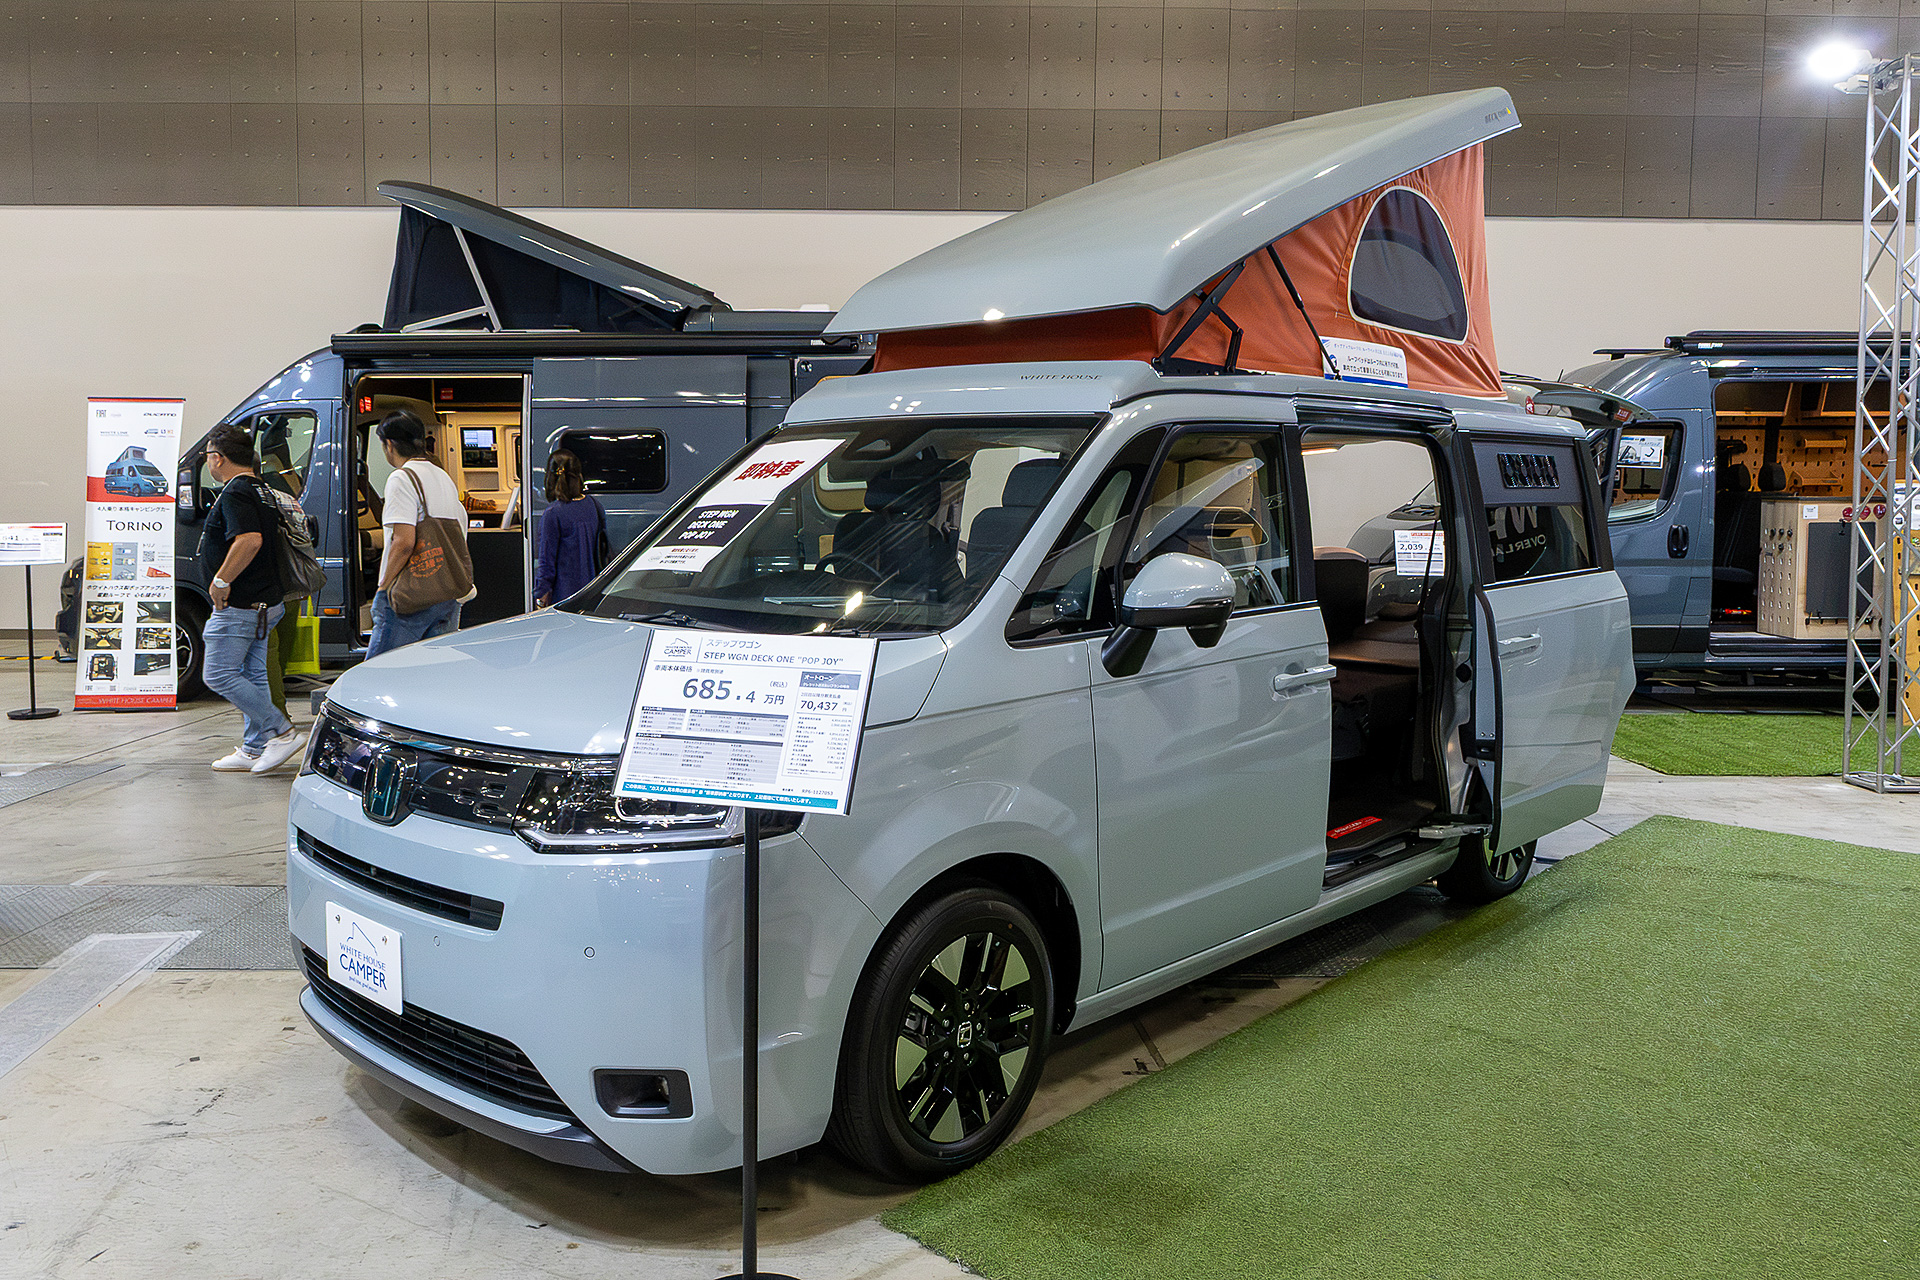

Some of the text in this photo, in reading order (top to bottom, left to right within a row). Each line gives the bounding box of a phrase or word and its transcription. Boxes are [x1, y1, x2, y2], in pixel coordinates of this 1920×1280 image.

[733, 459, 806, 482] 即納車
[698, 510, 719, 519] STEP
[105, 519, 163, 531] TORINO
[687, 520, 729, 530] DECK ONE
[678, 531, 716, 540] POP JOY
[706, 639, 762, 649] ステップワゴン
[703, 651, 726, 660] STEP
[727, 652, 749, 661] WGN
[750, 654, 774, 663] DECK
[776, 655, 796, 664] ONE
[654, 664, 693, 672] 車両本体価格
[803, 674, 834, 682] オートローン
[763, 694, 785, 705] 万円
[800, 700, 839, 711] 70,437
[339, 942, 386, 972] WHITE HOUSE
[339, 953, 388, 991] CAMPER
